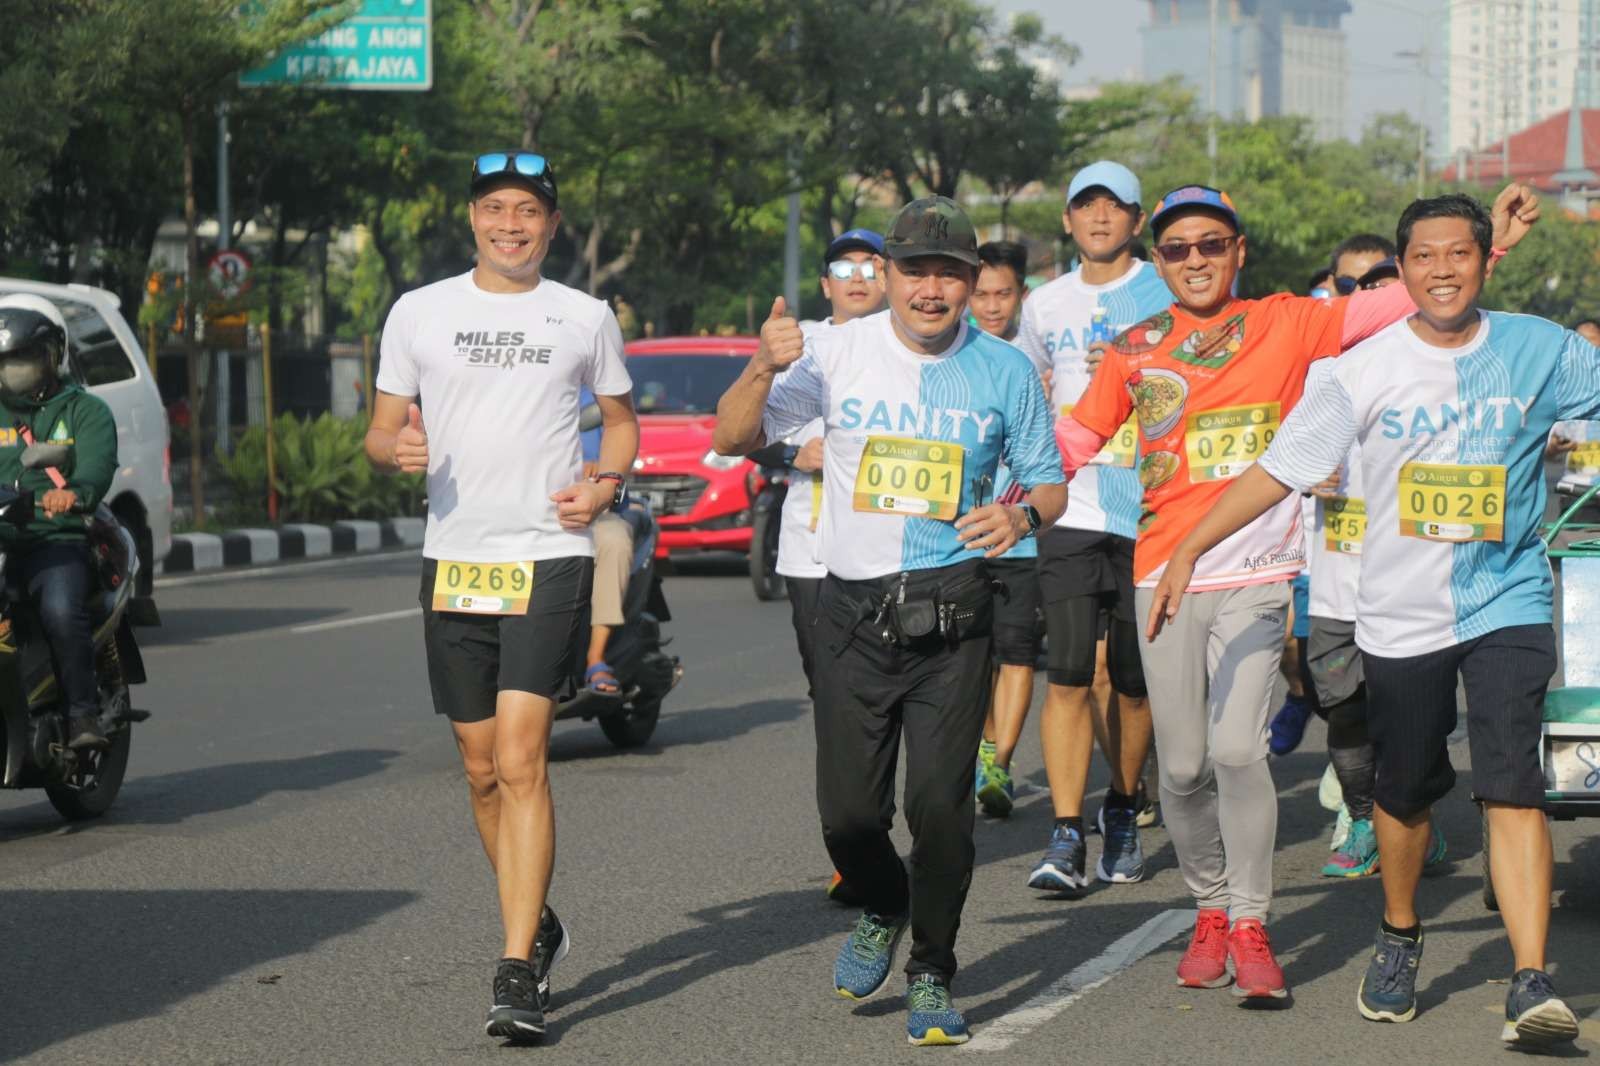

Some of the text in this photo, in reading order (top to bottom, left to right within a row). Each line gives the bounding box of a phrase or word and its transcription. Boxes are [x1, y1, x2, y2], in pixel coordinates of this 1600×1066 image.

[454, 331, 526, 346] MILES
[839, 398, 994, 443] SANITY
[1381, 396, 1535, 440] SANITY
[1198, 429, 1275, 459] 0299
[868, 463, 952, 495] 0001
[1411, 490, 1498, 517] 0026
[1332, 519, 1367, 537] 05
[447, 564, 526, 591] 0269
